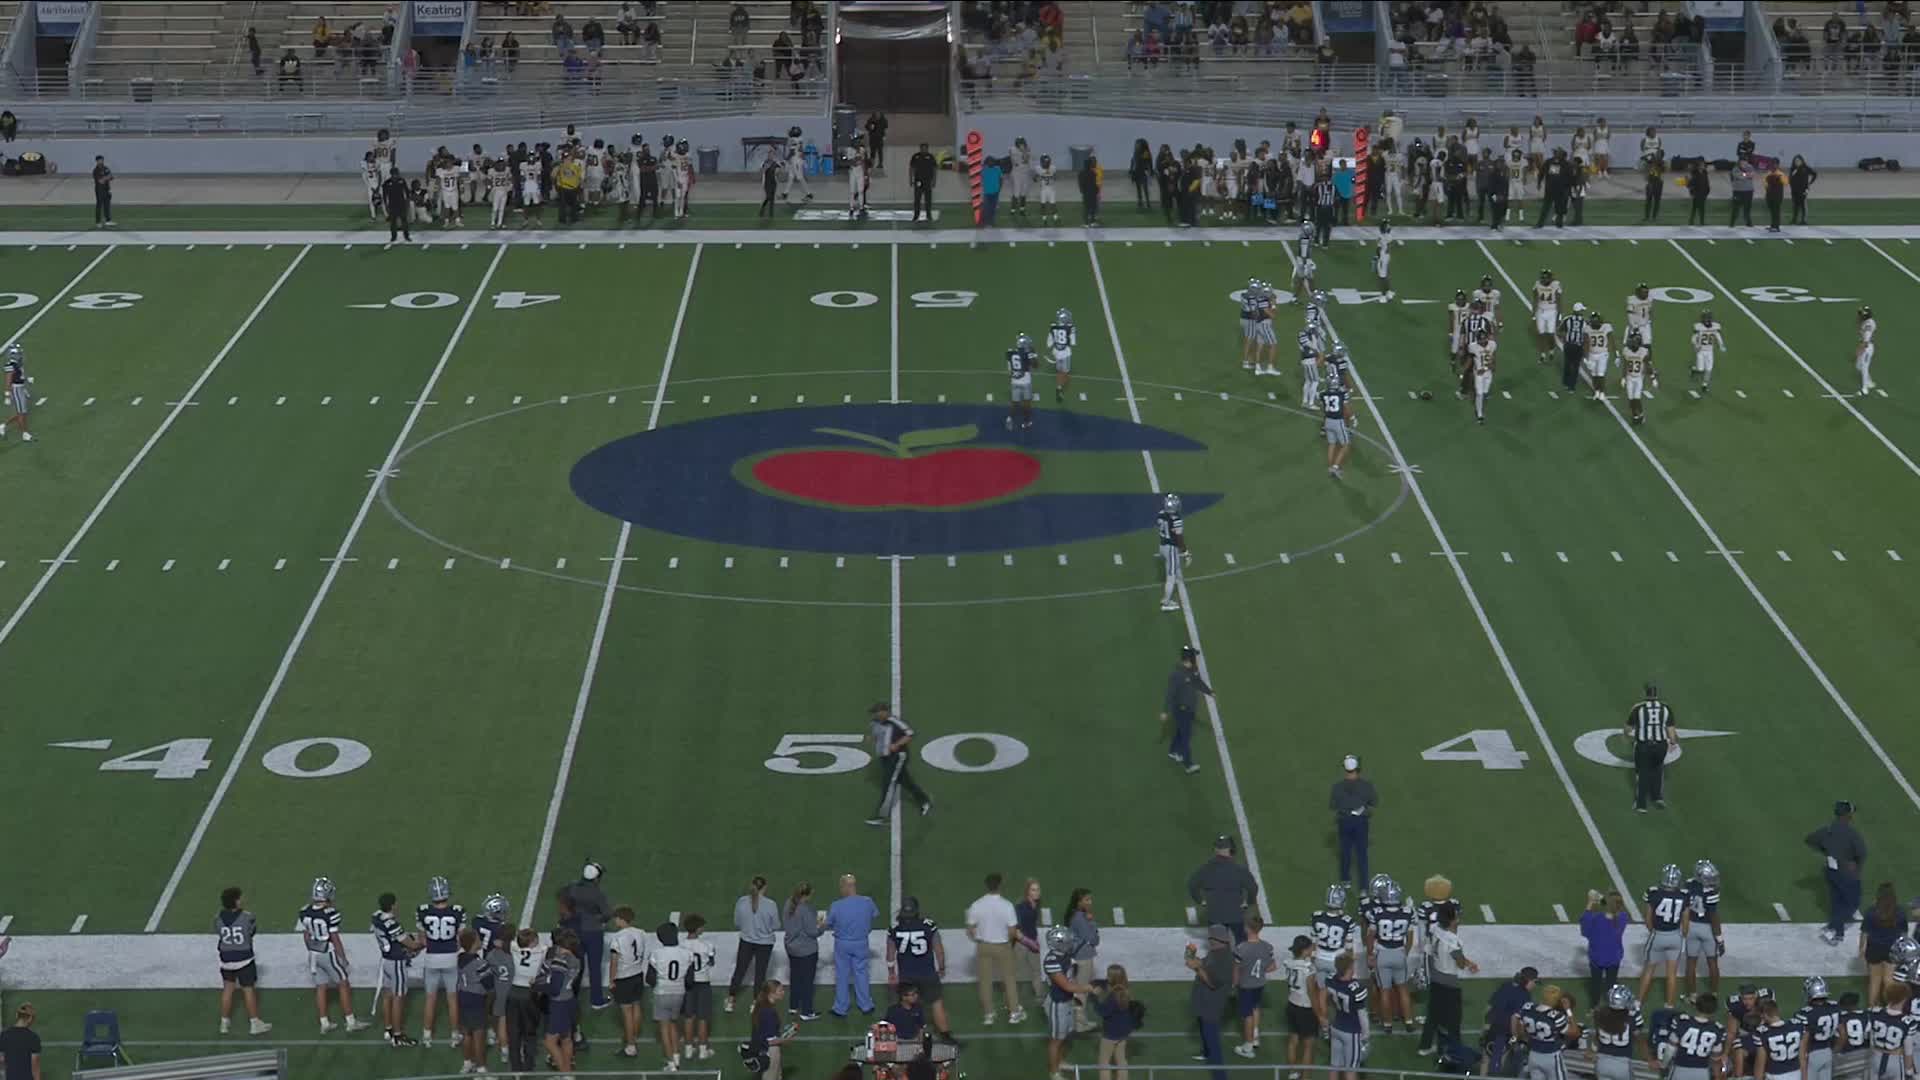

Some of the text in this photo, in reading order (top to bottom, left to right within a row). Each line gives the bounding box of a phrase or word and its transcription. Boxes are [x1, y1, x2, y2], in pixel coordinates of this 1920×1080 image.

[416, 5, 462, 17] Keating
[1052, 328, 1068, 345] 18
[1011, 354, 1022, 370] 6
[1323, 395, 1340, 412] 13
[1647, 708, 1661, 725] H
[1655, 897, 1684, 923] 41
[219, 926, 245, 945] 25
[423, 915, 457, 941] 36
[1313, 921, 1345, 949] 28
[1377, 919, 1409, 941] 82
[895, 930, 929, 956] 75
[519, 950, 531, 967] 2
[668, 960, 680, 980] 0
[1250, 959, 1262, 979] 4
[1679, 1026, 1718, 1058] 48
[1873, 1020, 1903, 1050] 29
[1767, 1030, 1801, 1062] 52
